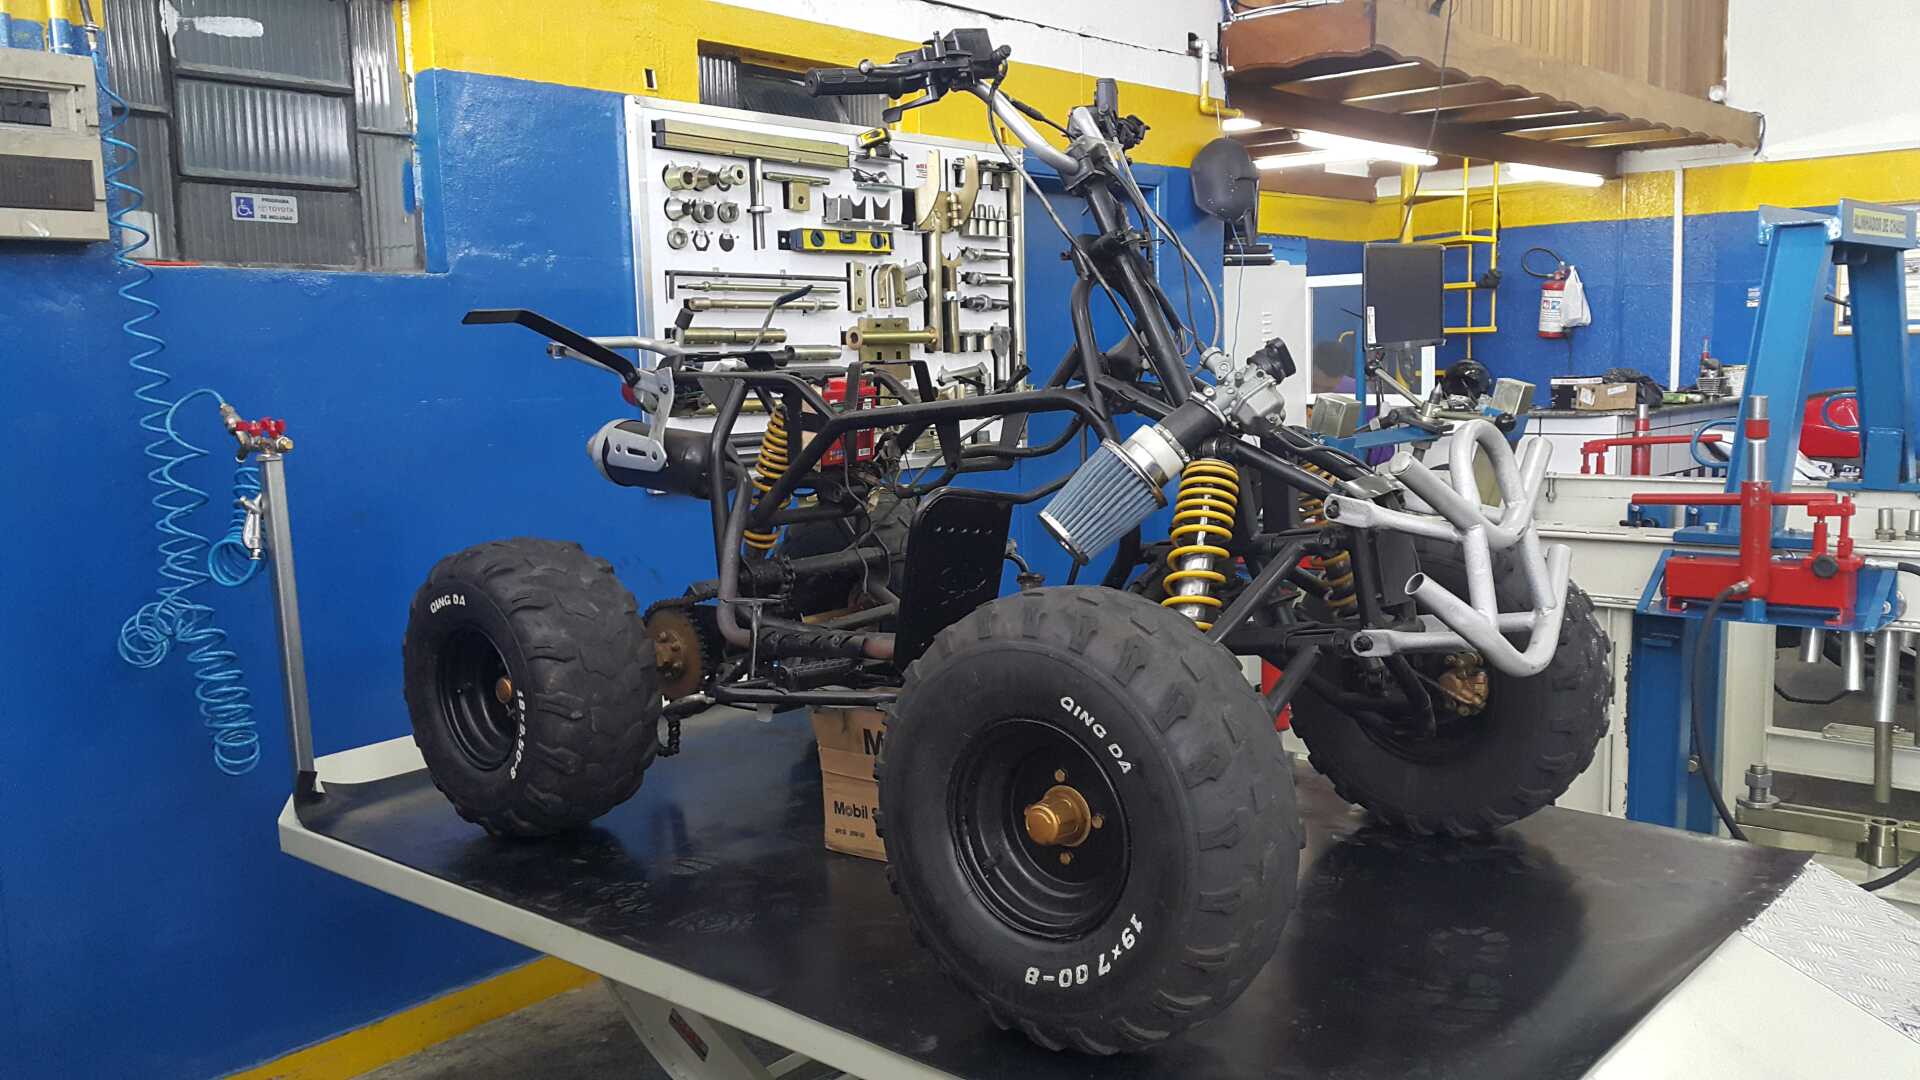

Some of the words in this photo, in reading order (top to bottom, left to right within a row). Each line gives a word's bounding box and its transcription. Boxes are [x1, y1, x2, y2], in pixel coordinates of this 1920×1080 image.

[430, 594, 451, 614] QING
[452, 593, 466, 606] DA
[1060, 696, 1107, 739] QING
[1108, 743, 1132, 774] DA
[834, 800, 868, 820] Mobil
